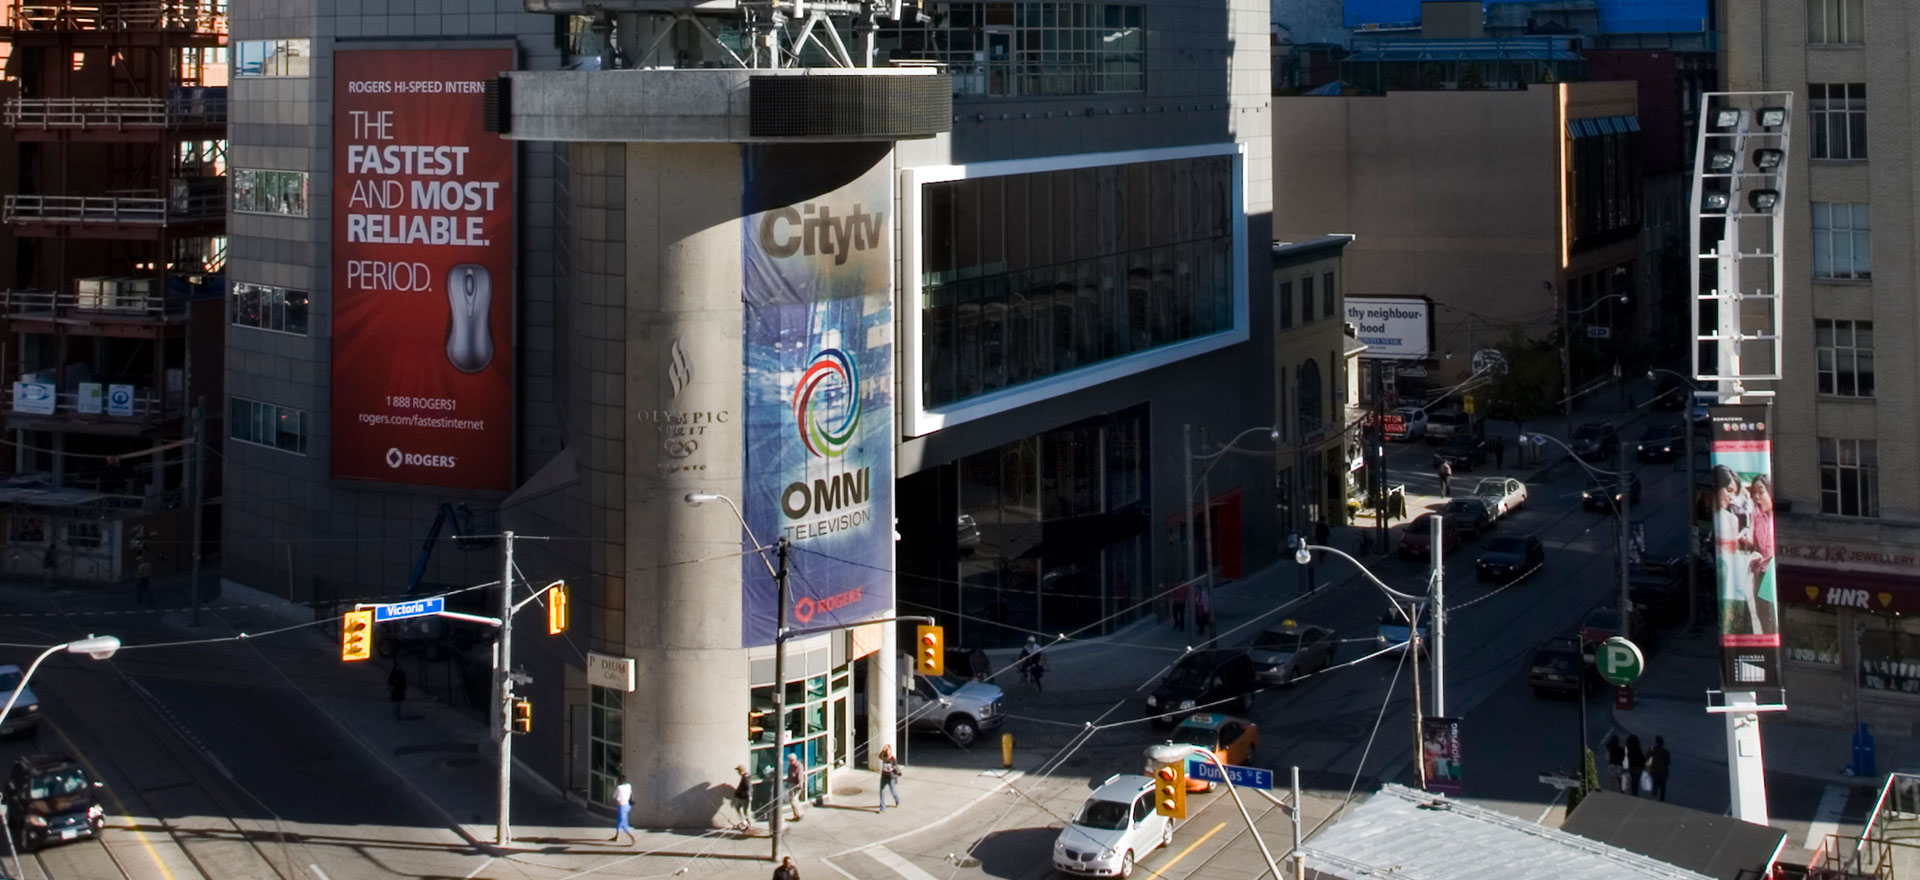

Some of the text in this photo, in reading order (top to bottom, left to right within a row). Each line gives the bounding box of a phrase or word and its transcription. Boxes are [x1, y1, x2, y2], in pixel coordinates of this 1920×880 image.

[349, 81, 391, 93] ROGERS
[394, 81, 442, 93] HI-SPEED
[349, 111, 394, 140] THE
[348, 145, 469, 175] FASTEST
[348, 180, 499, 211] AND MOST
[348, 214, 490, 246] RELIABLE.
[761, 203, 883, 266] Citytv
[347, 260, 432, 292] PERIOD.
[1348, 307, 1423, 321] thy neighbour-
[1360, 323, 1385, 333] hood
[386, 396, 456, 411] 1 888 ROGERS1
[358, 413, 485, 430] rogers.com/fastestinternet
[638, 410, 729, 424] OLYMPIC
[404, 453, 456, 468] ROGERS
[781, 466, 870, 520] OMNI
[783, 508, 871, 541] TELEVISION
[1780, 545, 1801, 557] THE
[1848, 551, 1915, 565] JEWELLERY
[387, 603, 424, 617] Victoria
[817, 586, 864, 614] ROGERS
[1826, 586, 1870, 609] HNR
[1607, 645, 1635, 674] P
[1450, 722, 1461, 767] SHOPPING
[1199, 764, 1243, 782] Dunas
[1255, 771, 1263, 784] E
